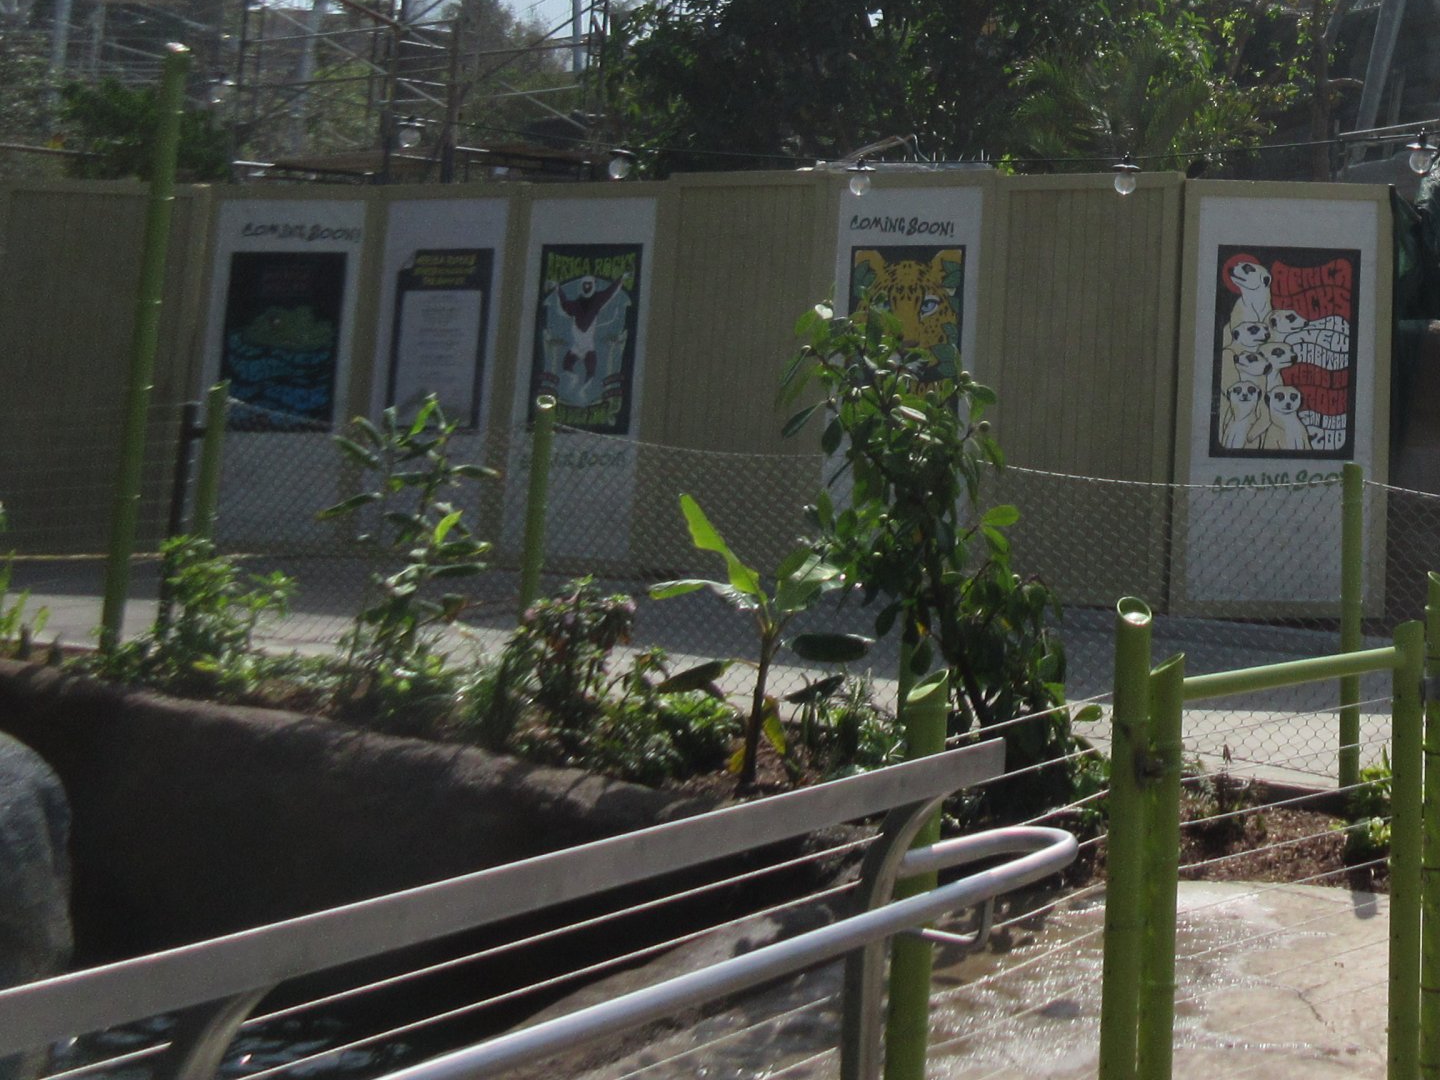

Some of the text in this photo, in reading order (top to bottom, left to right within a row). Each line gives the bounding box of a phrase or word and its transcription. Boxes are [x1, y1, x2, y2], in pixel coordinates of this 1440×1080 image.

[851, 215, 955, 238] COMING SOON!
[1271, 259, 1351, 296] AFRICA
[1271, 287, 1351, 321] ROCKS
[1284, 329, 1350, 353] NEW
[1299, 385, 1348, 415] ROCK
[1298, 410, 1321, 427] SAN
[1307, 426, 1346, 450] ZOO
[1293, 469, 1343, 491] SOO
